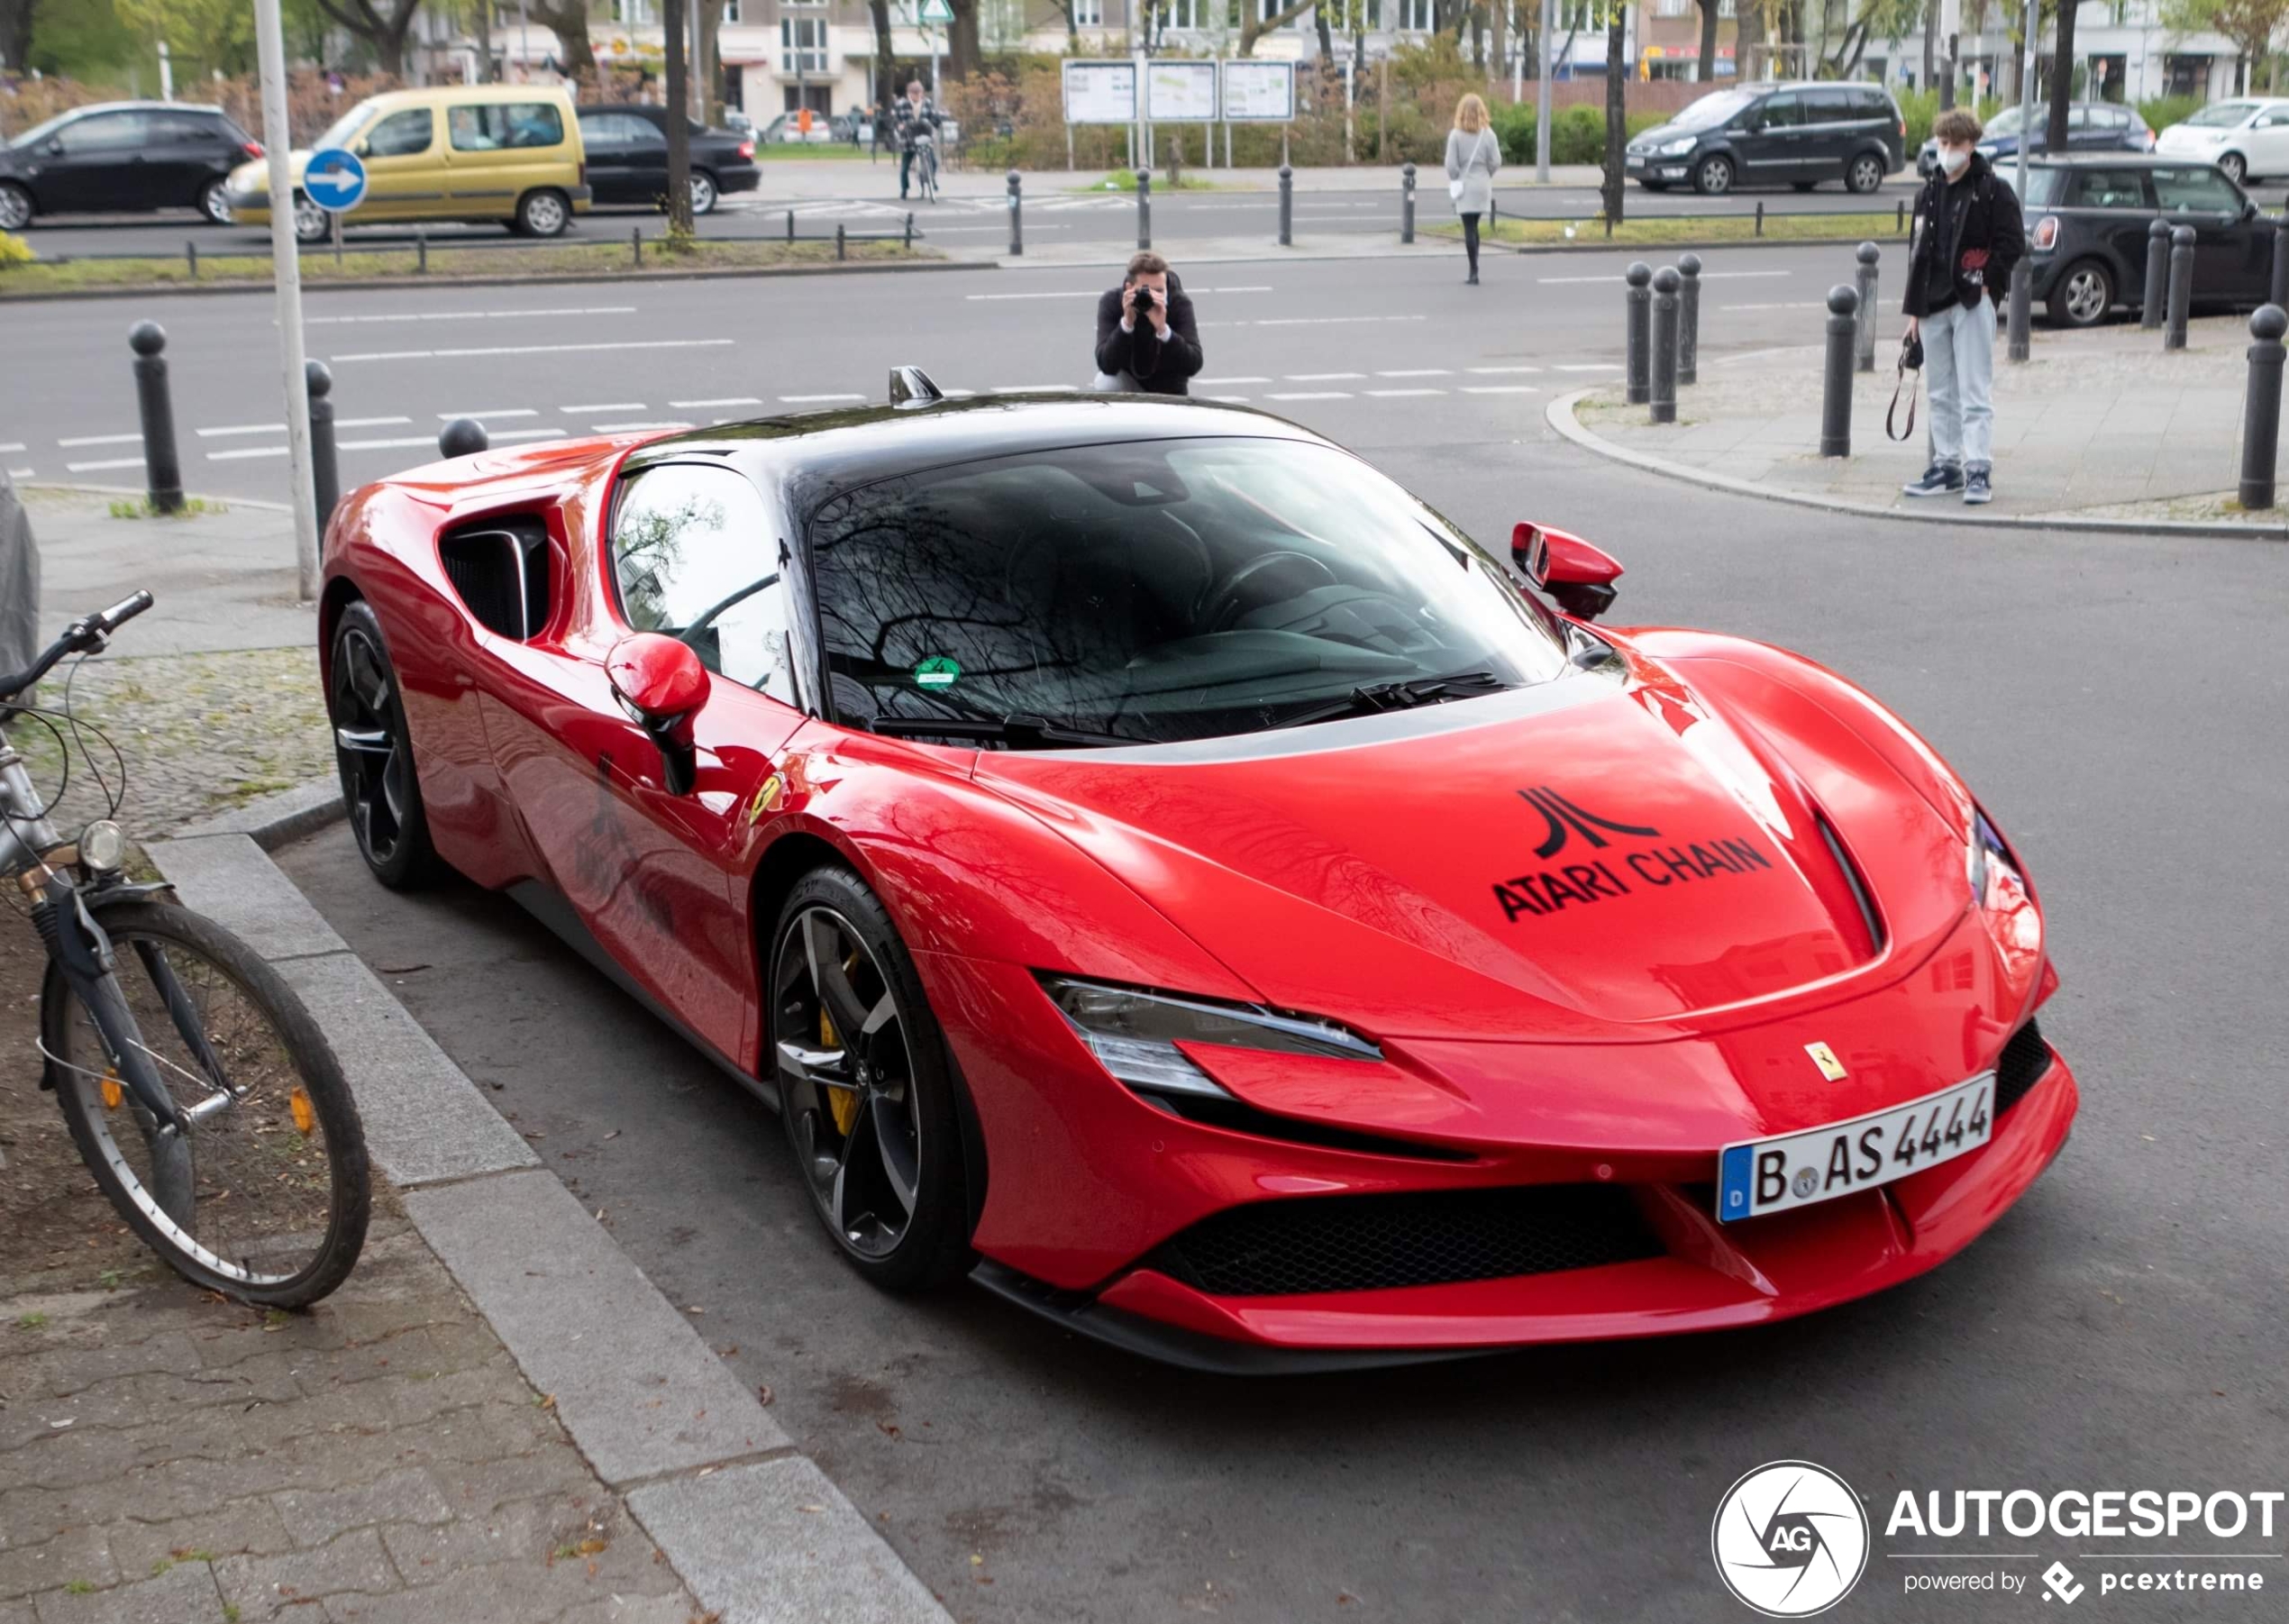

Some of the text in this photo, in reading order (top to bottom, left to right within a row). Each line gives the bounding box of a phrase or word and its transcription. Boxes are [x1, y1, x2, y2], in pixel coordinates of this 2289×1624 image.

[932, 659, 945, 673] 4
[1492, 838, 1772, 922] ATARI CHAIN
[1756, 1087, 1987, 1206] B AS 4444
